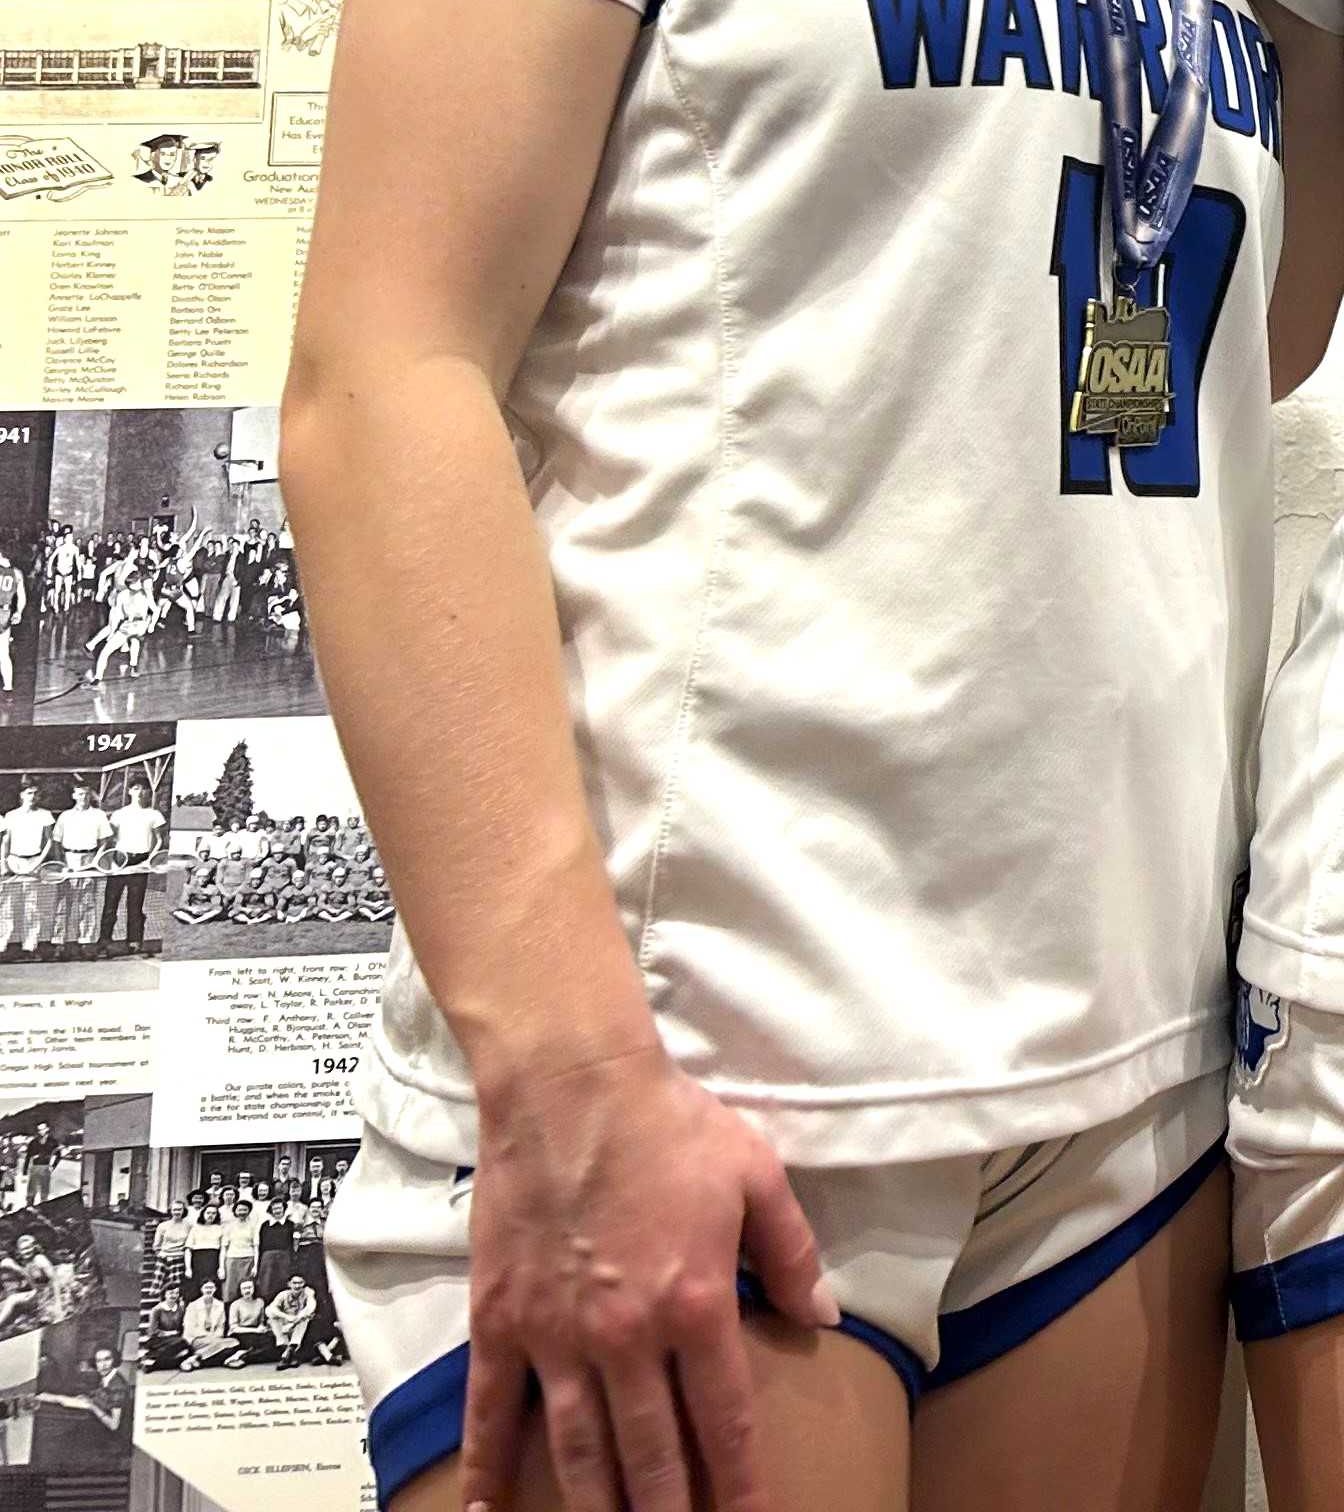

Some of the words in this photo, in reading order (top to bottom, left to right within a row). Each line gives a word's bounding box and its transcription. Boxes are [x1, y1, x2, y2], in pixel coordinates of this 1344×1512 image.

[44, 152, 86, 169] ROLL
[59, 163, 96, 180] 1940
[243, 170, 320, 182] Graduation
[1090, 344, 1168, 394] OSAA
[86, 734, 137, 753] 1947
